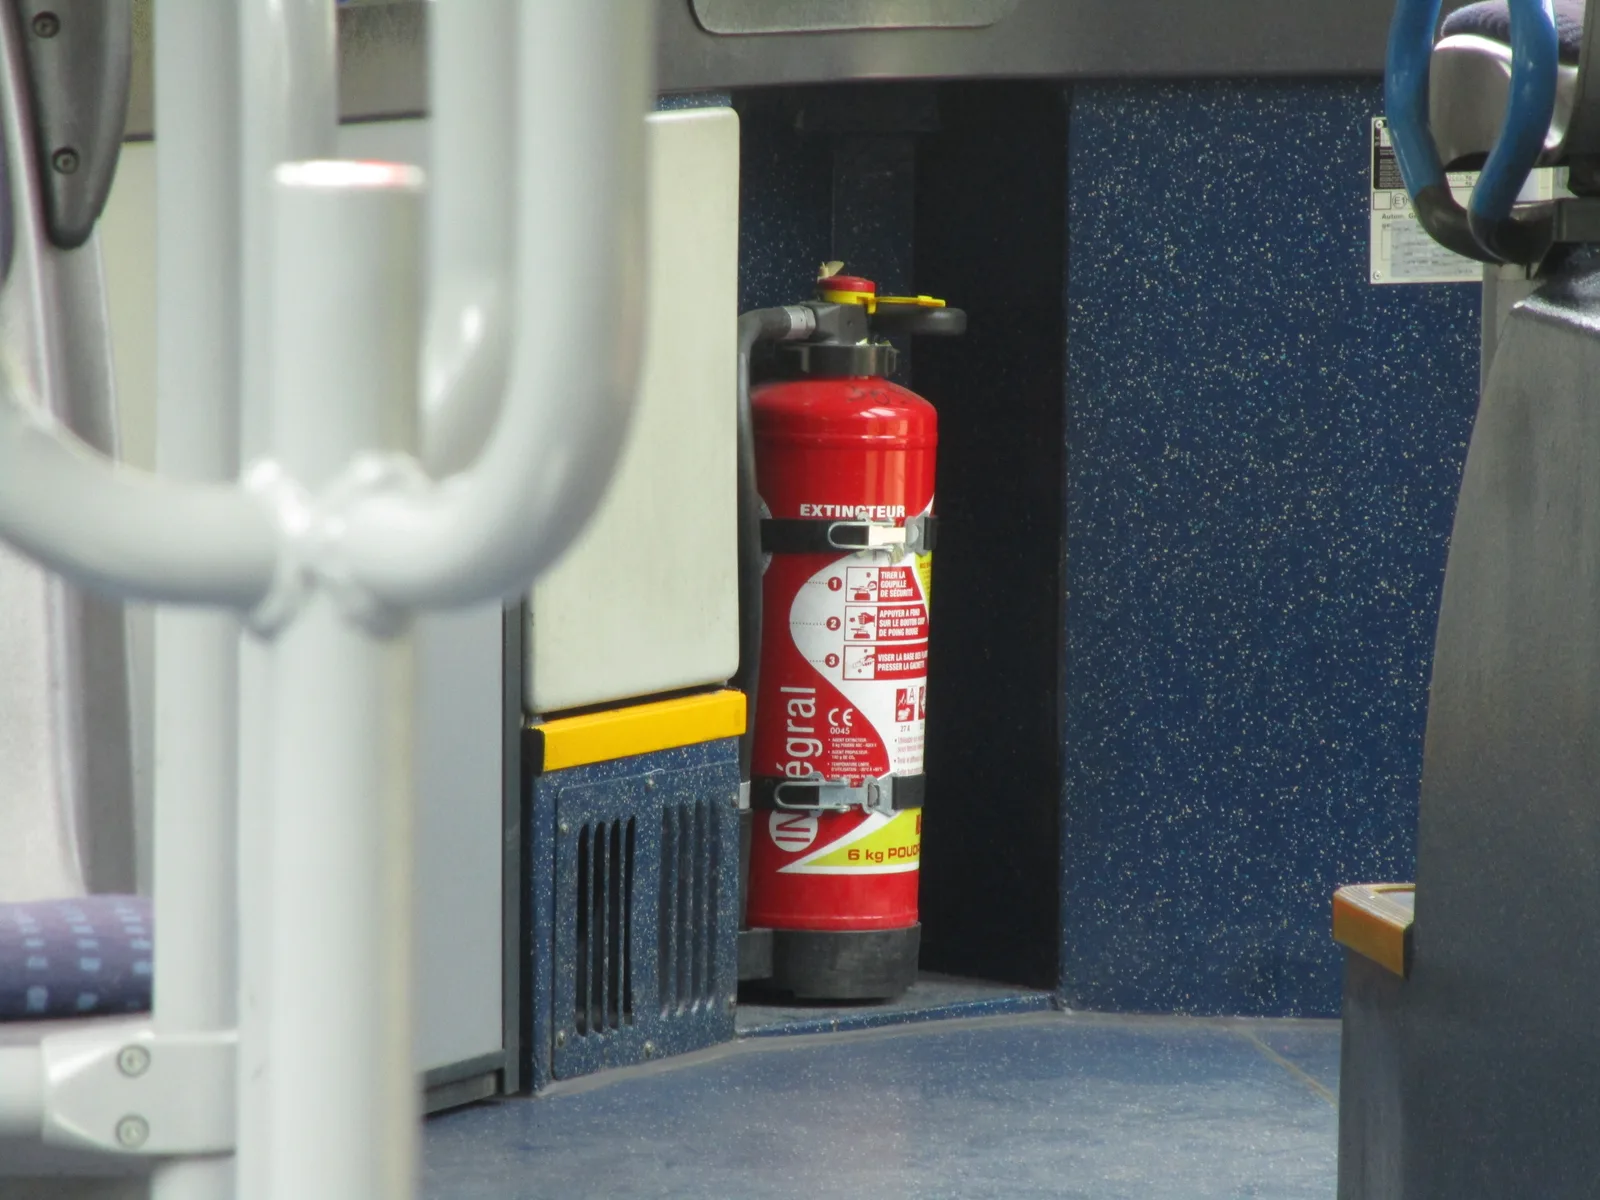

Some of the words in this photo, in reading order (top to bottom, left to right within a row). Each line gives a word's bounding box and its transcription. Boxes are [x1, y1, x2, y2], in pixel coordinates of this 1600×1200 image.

[800, 503, 905, 518] EXTINCTEUR
[880, 571, 898, 579] TIRER
[898, 571, 906, 579] LA
[880, 580, 907, 589] GOUPILLE
[880, 589, 888, 598] DE
[879, 609, 905, 618] APPUYER
[879, 619, 891, 628] SUR
[892, 619, 899, 627] LE
[879, 628, 887, 637] DE
[888, 627, 905, 637] POING
[877, 653, 895, 662] VISER
[895, 653, 903, 661] LA
[903, 652, 915, 661] BASE
[877, 662, 903, 672] PRESSER
[903, 662, 909, 671] LA
[830, 727, 850, 735] 0045
[847, 849, 860, 861] 6
[865, 848, 884, 864] kg
